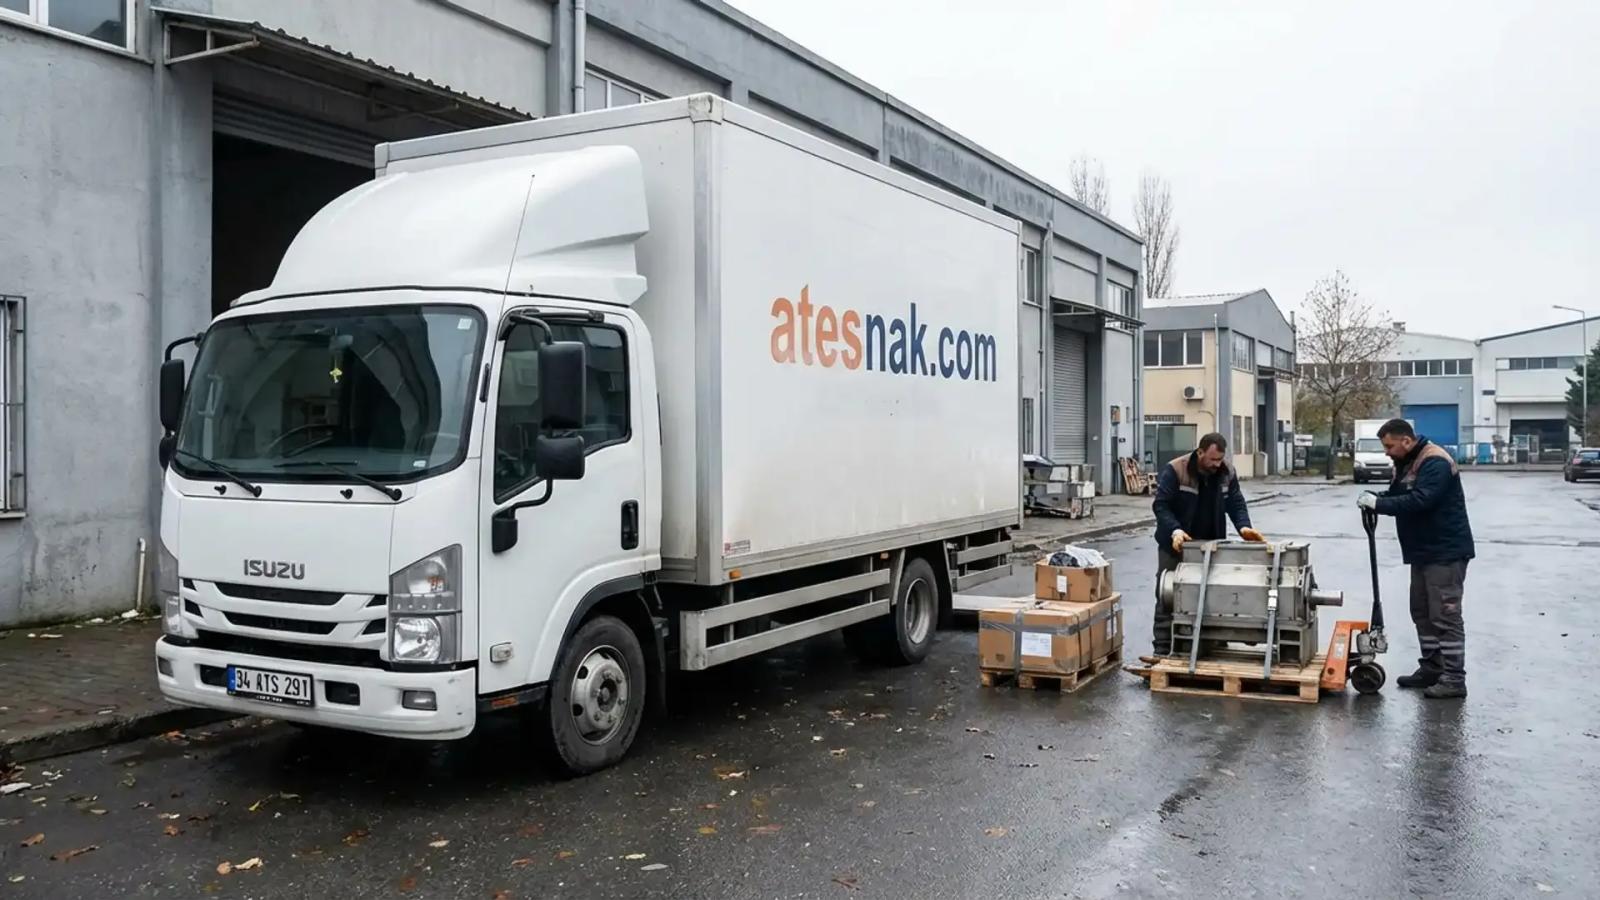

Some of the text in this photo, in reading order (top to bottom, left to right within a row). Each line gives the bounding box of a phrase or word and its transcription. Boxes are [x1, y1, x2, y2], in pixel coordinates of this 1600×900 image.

[770, 284, 997, 382] atesnak.com
[244, 559, 305, 580] ISUZU
[236, 669, 307, 698] 34 ATS 291
